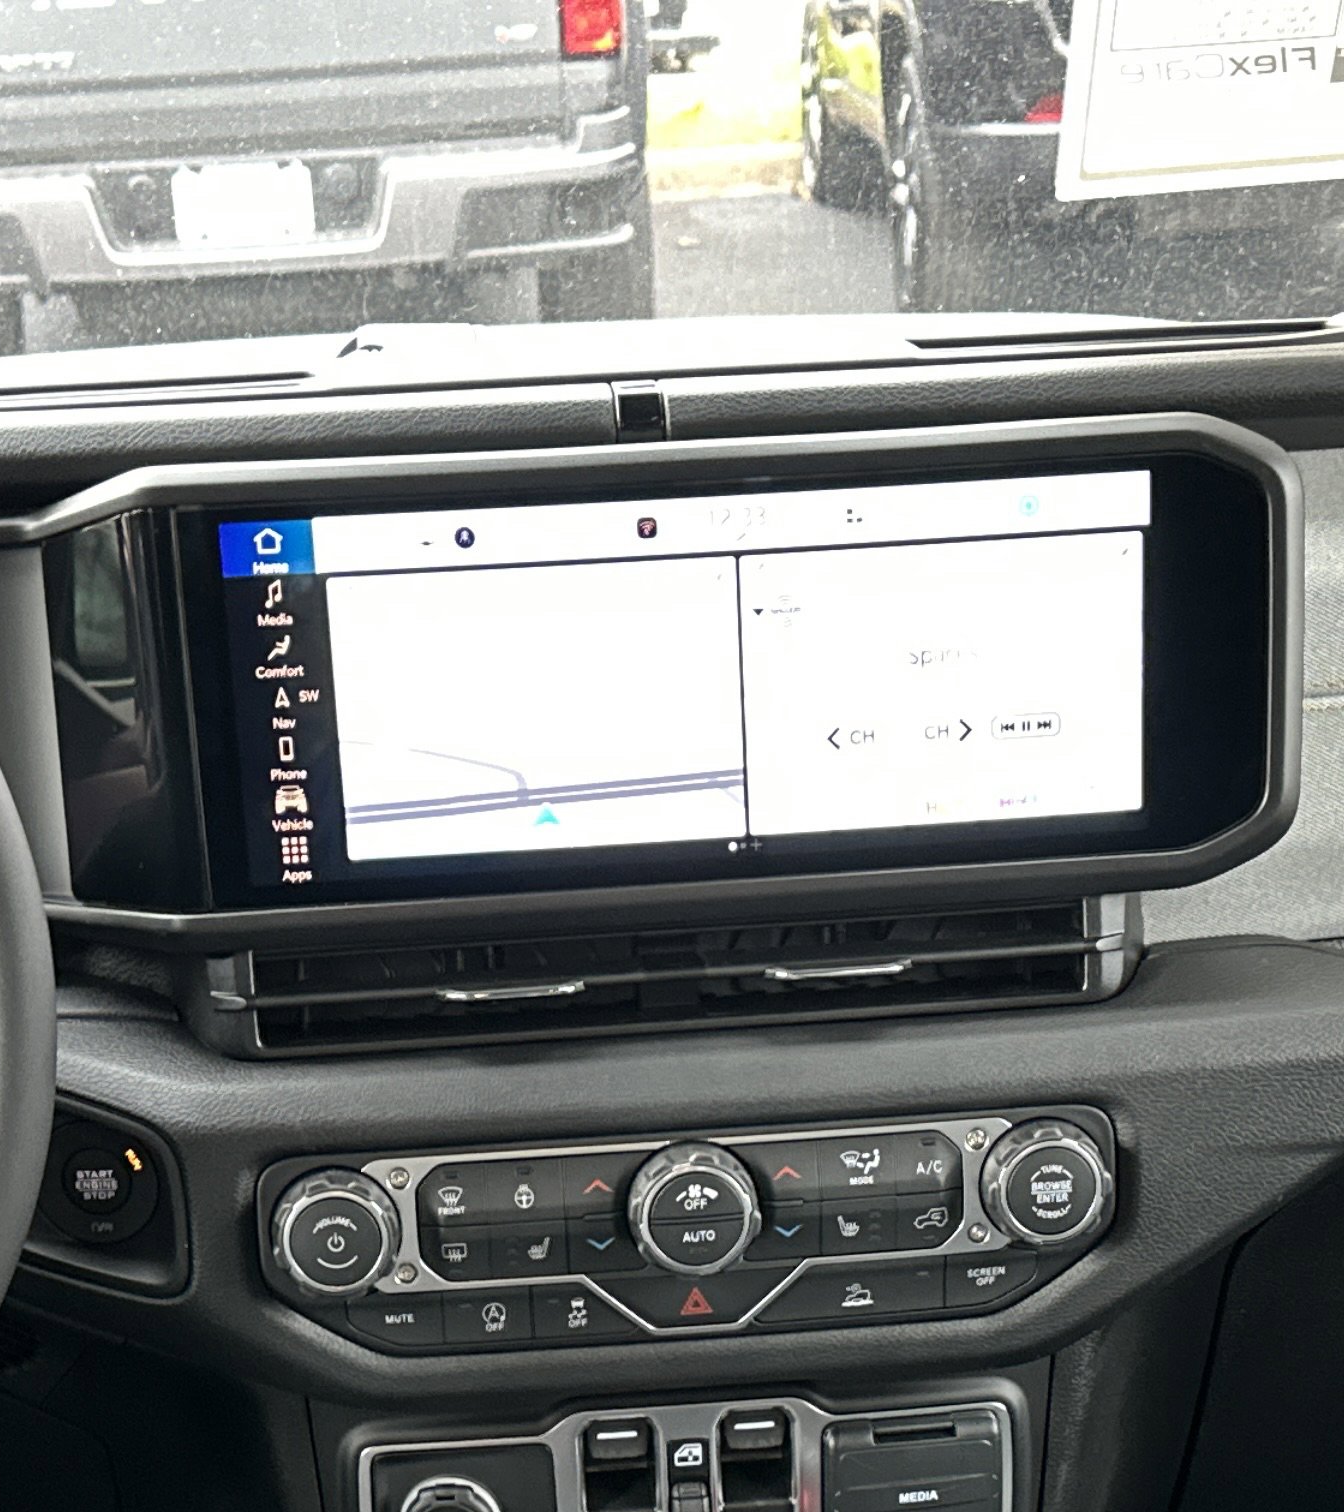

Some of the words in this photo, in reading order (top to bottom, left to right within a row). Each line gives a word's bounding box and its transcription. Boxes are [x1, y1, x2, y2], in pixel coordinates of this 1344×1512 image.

[257, 613, 293, 626] Media
[255, 665, 304, 679] Comfort
[299, 690, 319, 703] SW
[272, 718, 296, 729] Nav
[849, 730, 875, 745] CH
[924, 725, 949, 739] CH
[270, 769, 307, 781] Phone
[272, 818, 313, 832] Vehicle
[282, 870, 312, 883] Apps
[916, 1159, 943, 1175] A/C
[1041, 1164, 1063, 1173] TUNE
[76, 1170, 113, 1179] START
[849, 1175, 875, 1185] MODE
[75, 1179, 118, 1191] ENGINE
[1031, 1179, 1073, 1192] BROWSE
[84, 1191, 115, 1200] STOP
[1036, 1192, 1069, 1204] ENTER
[438, 1205, 466, 1216] FRONT
[684, 1199, 708, 1211] OFF
[1036, 1205, 1067, 1219] SCROLL
[683, 1229, 715, 1243] AUTO
[967, 1266, 1006, 1278] SCREEN
[976, 1275, 996, 1286] OFF
[385, 1314, 414, 1324] MUTE
[568, 1318, 587, 1328] OFF
[485, 1322, 504, 1332] OFF
[898, 1490, 939, 1504] MEDIA
